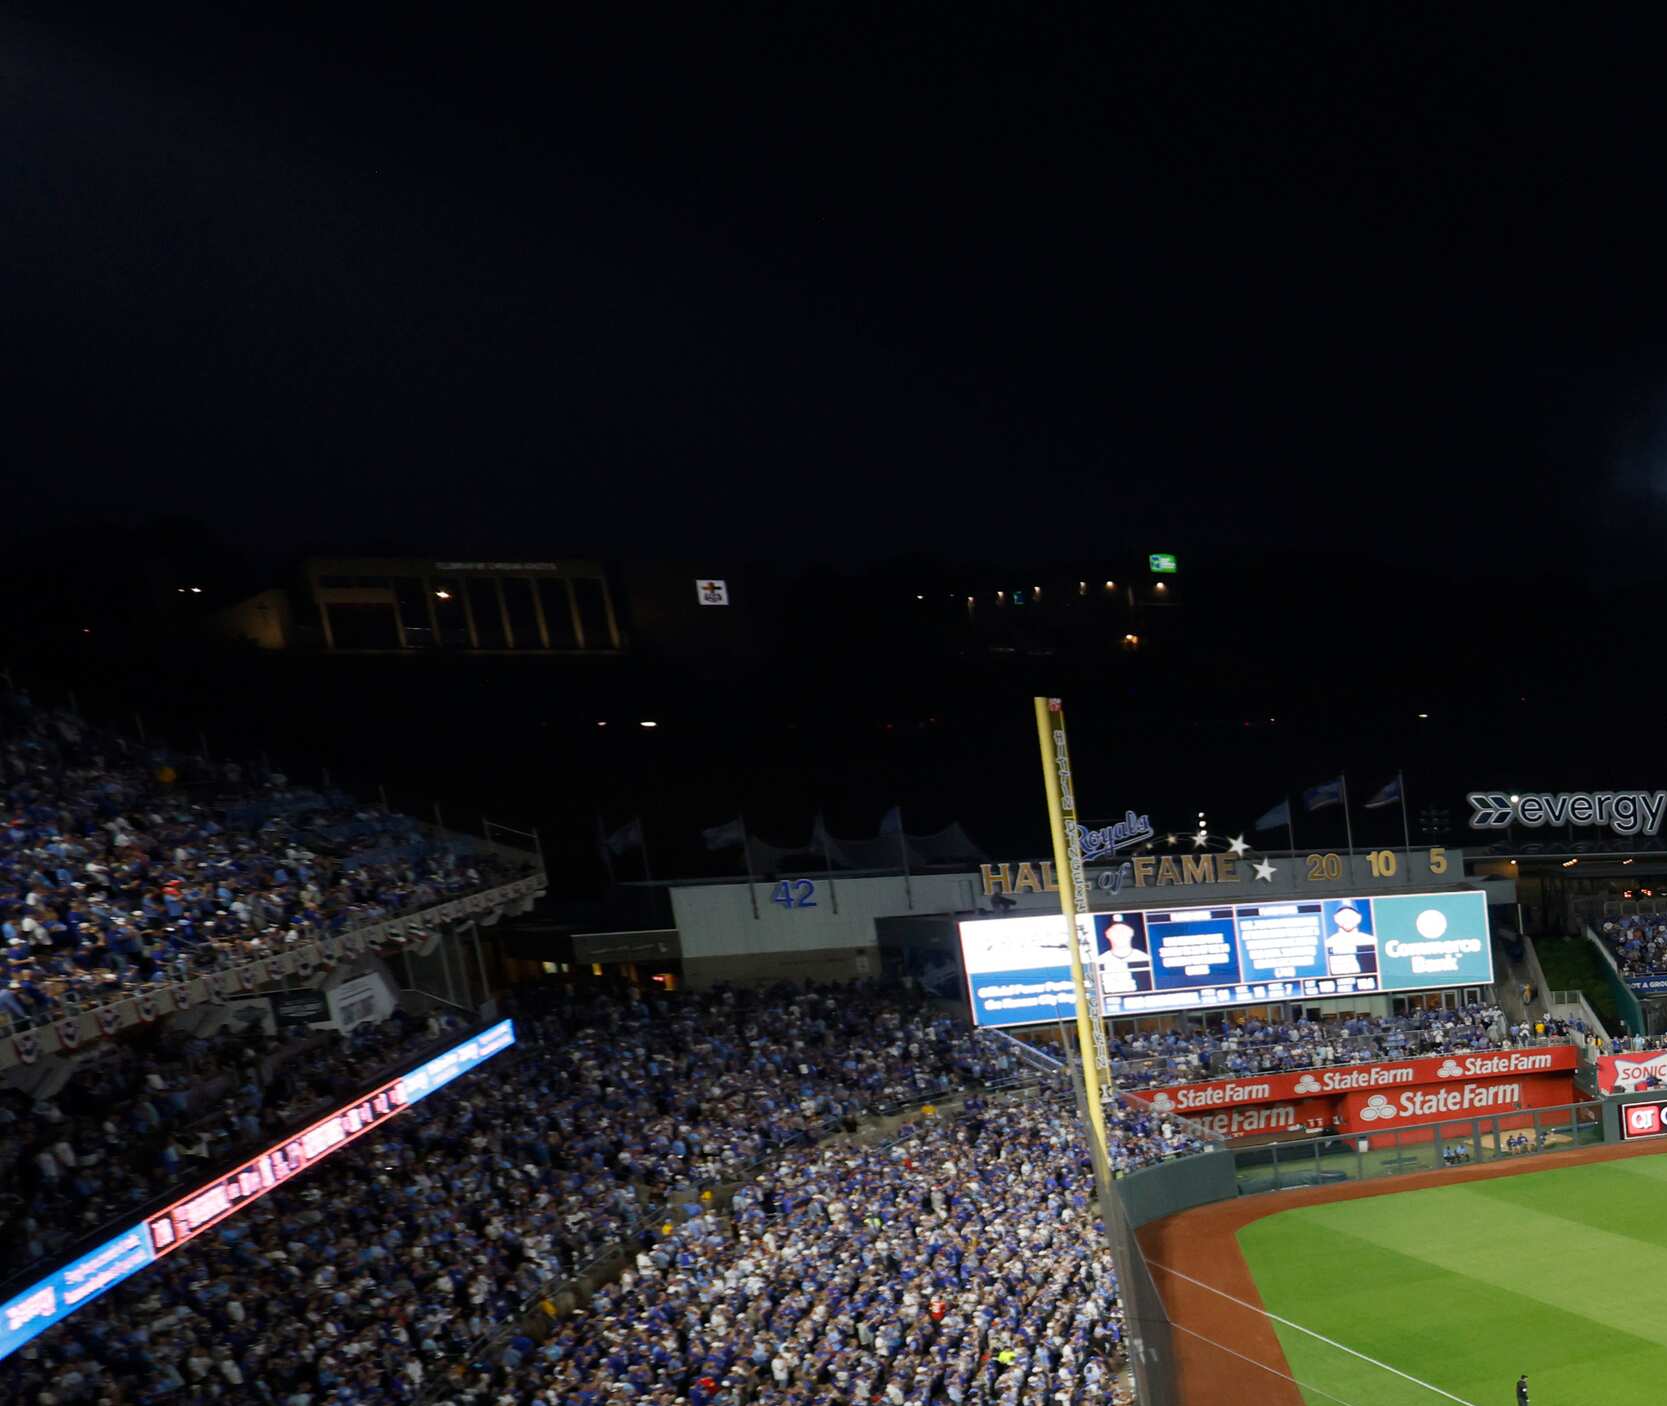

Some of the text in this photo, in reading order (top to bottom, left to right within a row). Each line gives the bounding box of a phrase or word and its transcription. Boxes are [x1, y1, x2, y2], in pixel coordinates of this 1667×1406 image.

[1074, 810, 1153, 858] Royals
[1099, 852, 1240, 895] of FAME
[1306, 854, 1341, 881] 20
[1366, 851, 1396, 878] 10
[1429, 847, 1447, 875] 5
[770, 879, 816, 909] 42
[1385, 938, 1481, 958] Commerce
[1412, 954, 1459, 973] Bank
[1621, 1061, 1667, 1083] SONIC
[1631, 1112, 1655, 1129] QT
